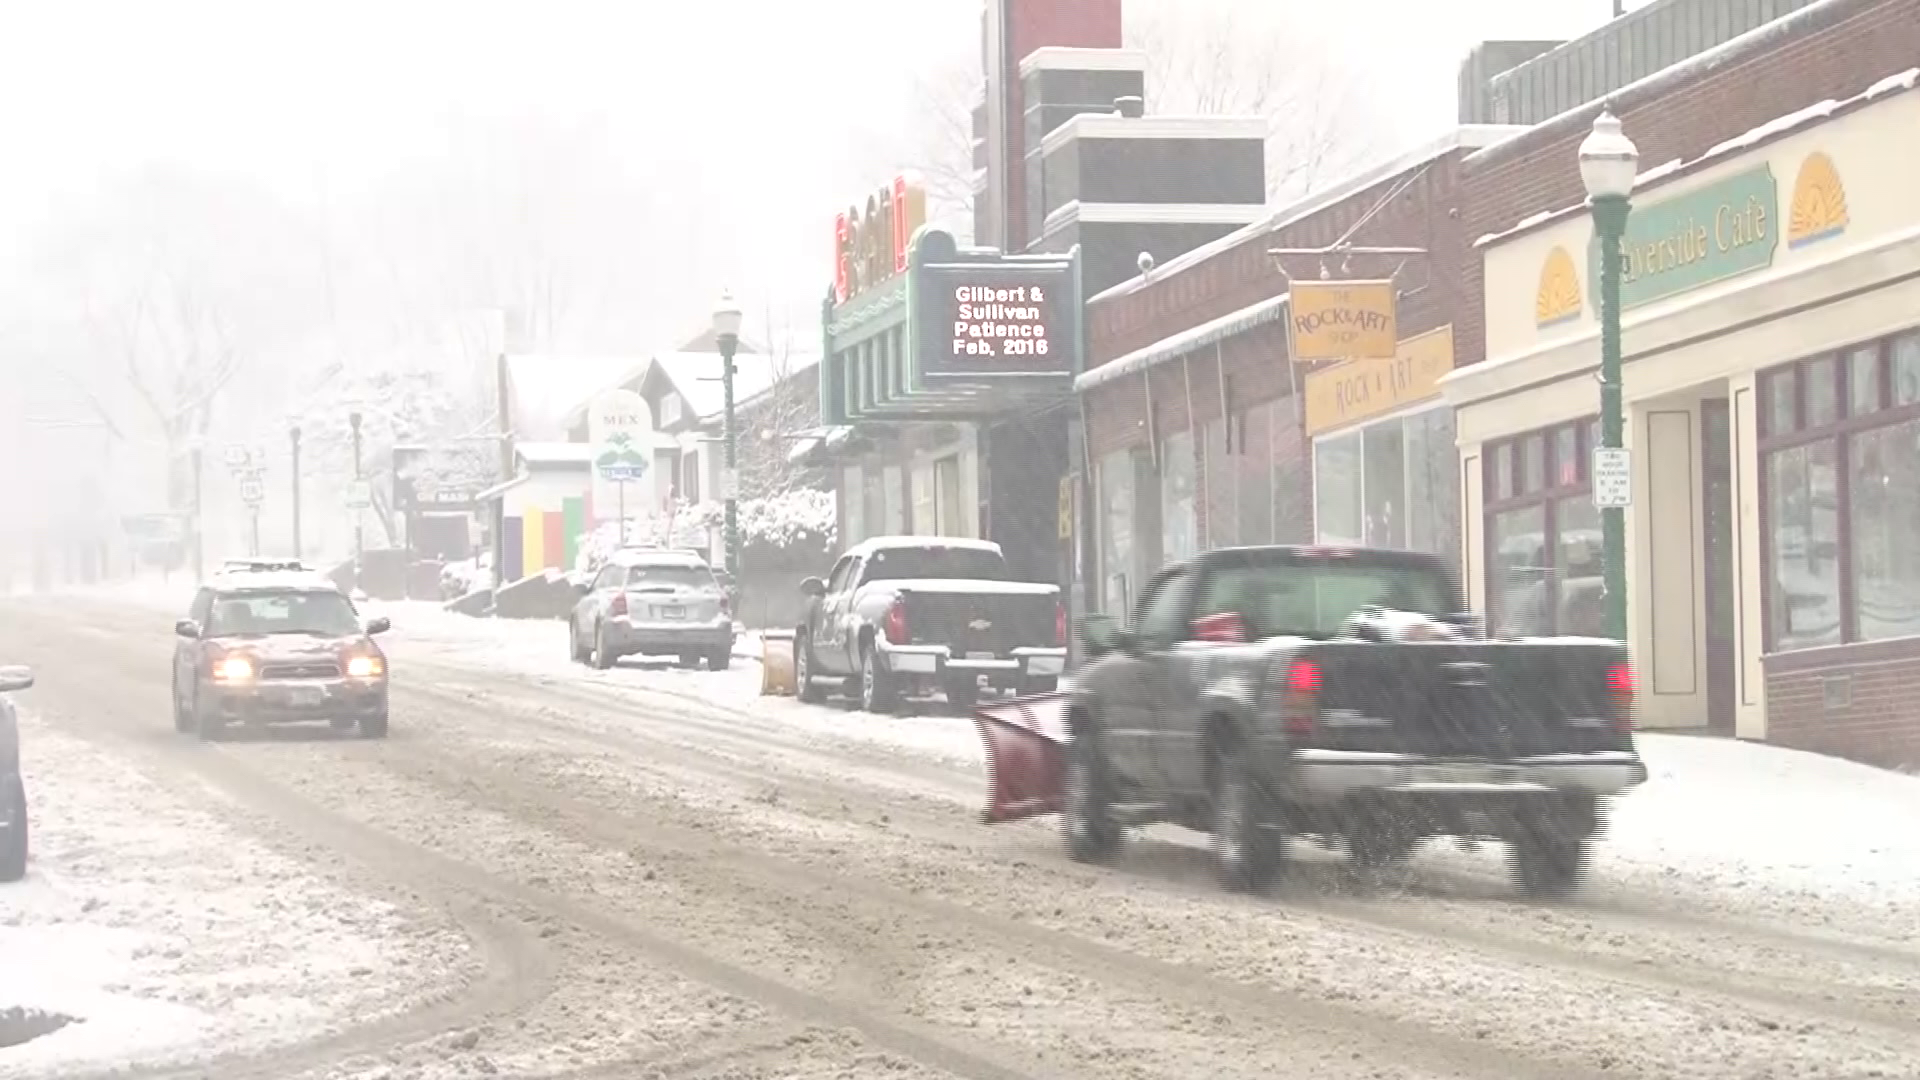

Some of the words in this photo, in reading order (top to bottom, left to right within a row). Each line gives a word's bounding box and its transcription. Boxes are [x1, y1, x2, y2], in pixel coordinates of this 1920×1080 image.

[955, 286, 1025, 302] Gilbert
[1030, 286, 1044, 302] &
[958, 303, 1040, 320] Sullivan
[954, 321, 1045, 337] Patience
[1003, 339, 1049, 355] 2016
[1336, 372, 1370, 415] ROCK
[1389, 356, 1413, 399] ART
